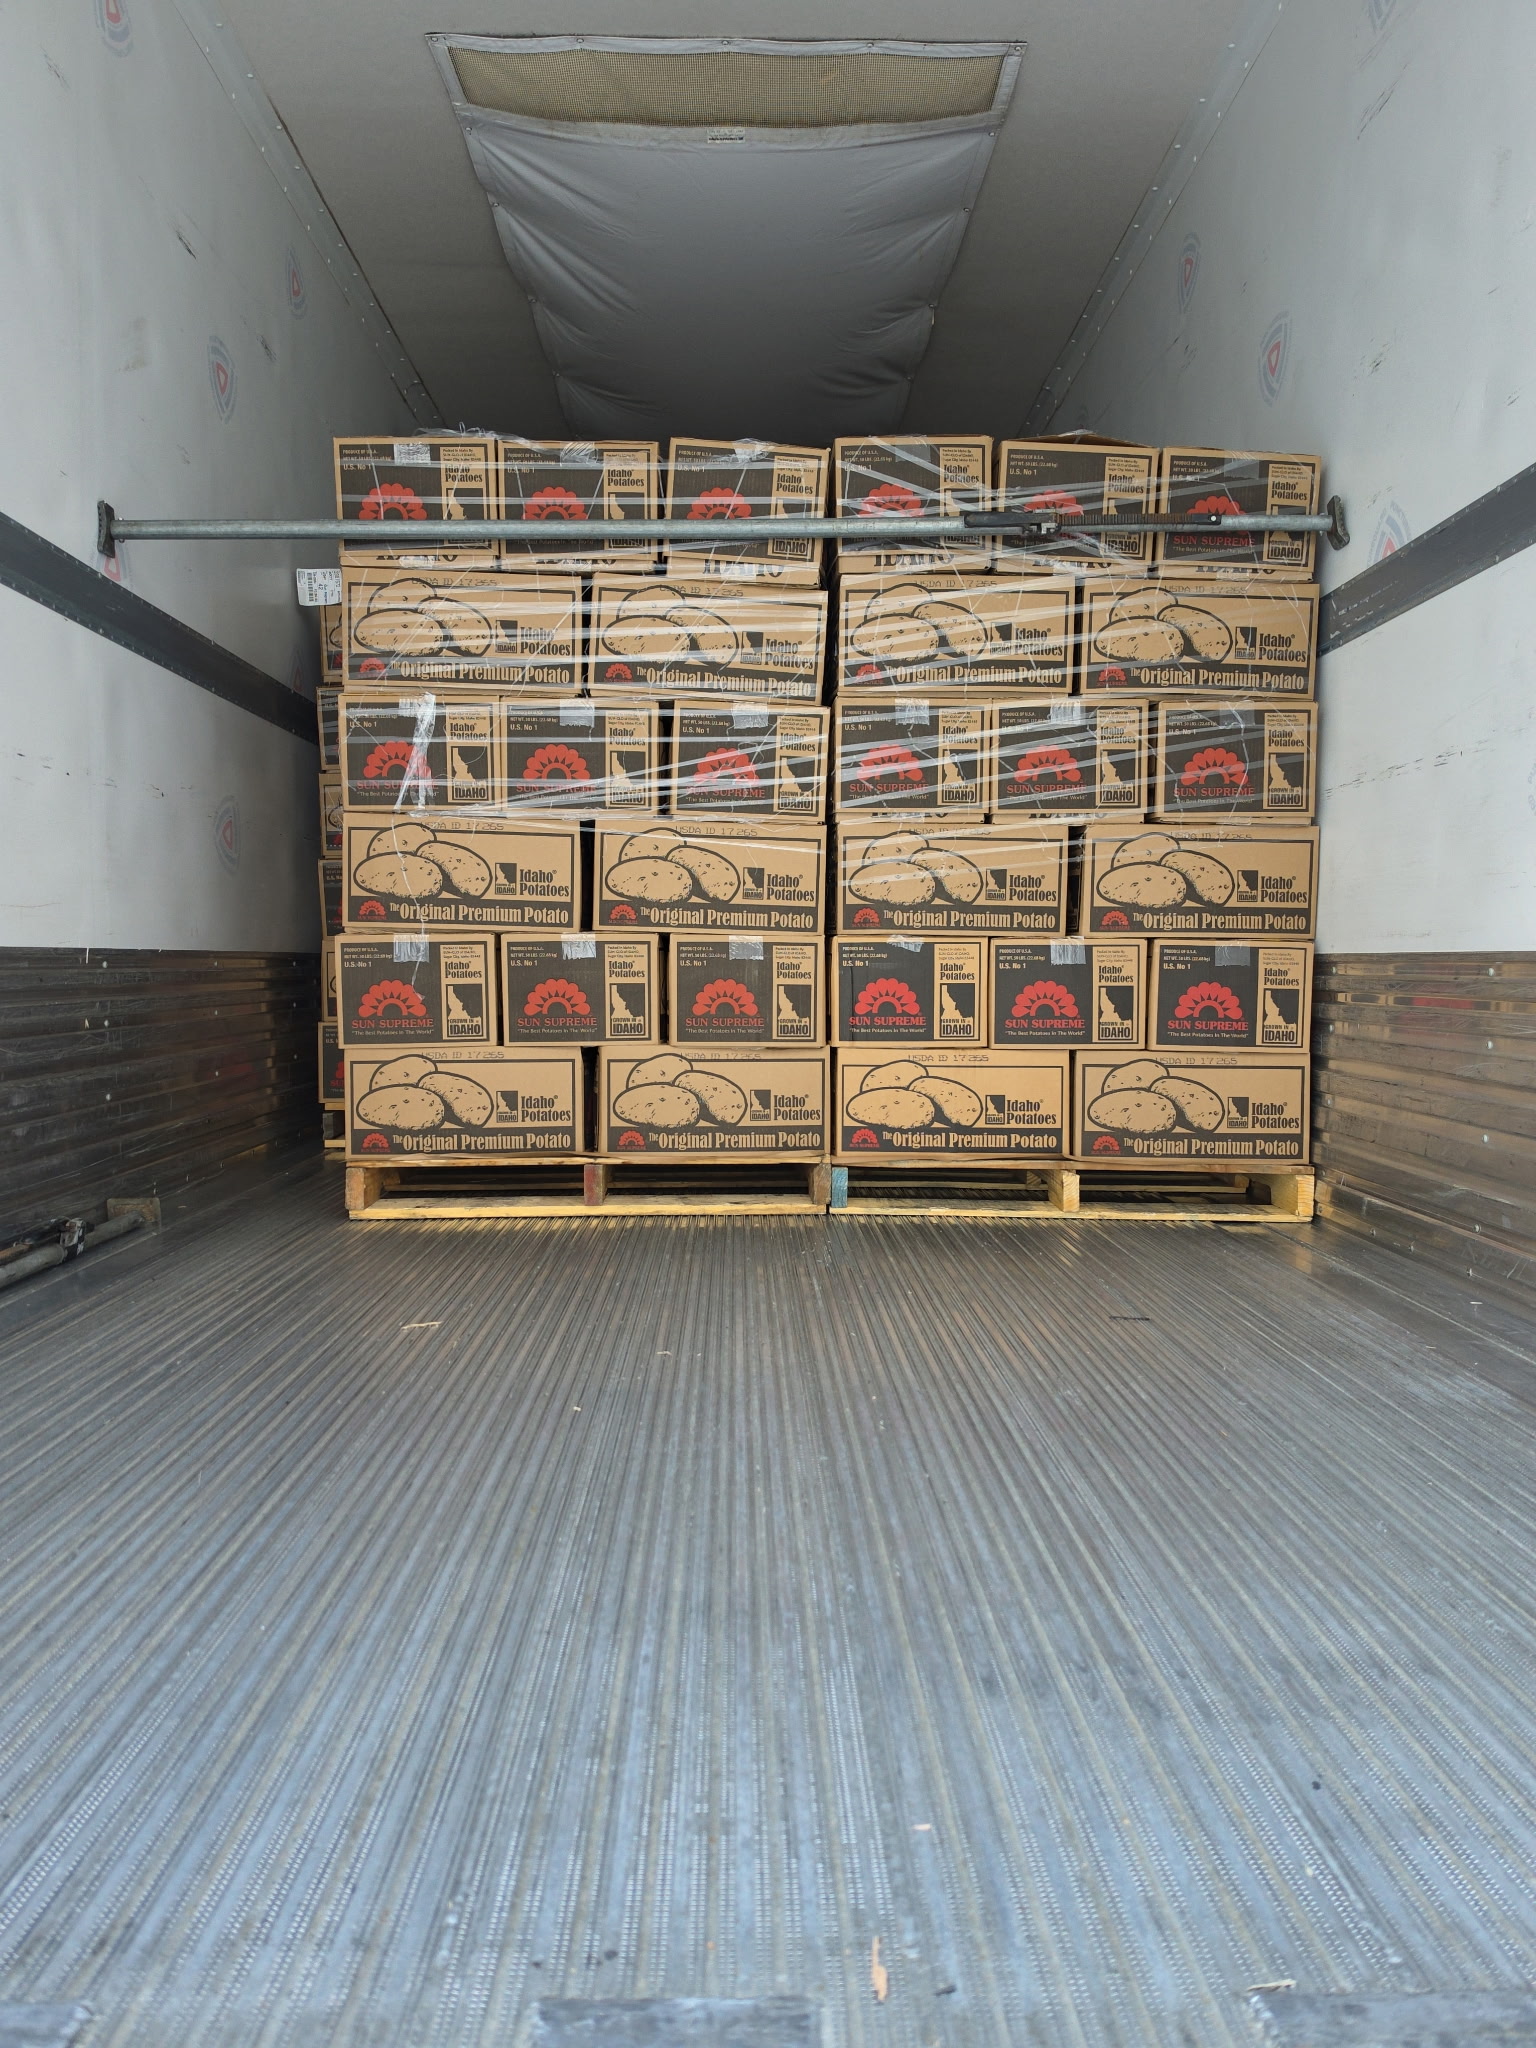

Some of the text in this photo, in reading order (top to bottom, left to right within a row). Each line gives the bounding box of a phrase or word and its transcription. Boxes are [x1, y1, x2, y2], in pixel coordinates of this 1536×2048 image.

[608, 468, 632, 478] Idaho
[608, 477, 644, 487] Potatoes
[1109, 474, 1133, 484] Idaho
[1109, 483, 1143, 493] Potatoes
[1272, 482, 1296, 491] Idaho
[1272, 491, 1307, 500] Potatoes
[1270, 547, 1300, 558] IDAHO
[765, 638, 798, 654] Idaho
[1260, 634, 1291, 648] Idaho
[765, 653, 814, 669] Potatoes
[1259, 649, 1306, 662] Potatoes
[401, 660, 456, 680] Original
[460, 662, 521, 681] Premium
[524, 665, 570, 684] Potato
[897, 666, 950, 684] Original
[955, 666, 1014, 683] Premium
[1018, 667, 1061, 683] Potato
[647, 668, 701, 690] Original
[705, 672, 764, 694] Premium
[768, 678, 811, 697] Potato
[1141, 668, 1195, 686] Original
[1200, 670, 1258, 687] Premium
[1262, 672, 1304, 689] Potato
[610, 728, 633, 737] Idaho
[1269, 729, 1292, 739] Idaho
[610, 737, 645, 747] Potatoes
[1269, 738, 1304, 748] Potatoes
[1174, 787, 1254, 798] SUN SUPREME
[1270, 794, 1300, 805] IDAHO
[519, 869, 552, 882] Idaho
[767, 874, 799, 887] Idaho
[1010, 875, 1041, 888] Idaho
[1261, 876, 1292, 889] Idaho
[520, 884, 569, 897] Potatoes
[767, 888, 814, 901] Potatoes
[1009, 889, 1056, 901] Potatoes
[1261, 890, 1307, 902] Potatoes
[390, 902, 568, 924] The Original Premium Potato
[641, 906, 813, 928] The Original Premium Potato
[884, 909, 1055, 928] The Original Premium Potato
[1134, 912, 1306, 931] The Original Premium Potato
[446, 961, 469, 970] Idaho
[610, 961, 633, 970] Idaho
[778, 962, 800, 971] Idaho
[941, 963, 963, 971] Idaho
[1099, 966, 1122, 974] Idaho
[446, 970, 481, 979] Potatoes
[610, 969, 644, 978] Potatoes
[778, 971, 811, 980] Potatoes
[940, 972, 974, 980] Potatoes
[1099, 974, 1133, 982] Potatoes
[1264, 968, 1288, 977] Idaho
[1264, 977, 1299, 986] Potatoes
[351, 1018, 434, 1029] SUN SUPREME
[517, 1017, 597, 1027] SUN SUPREME
[686, 1017, 764, 1027] SUN SUPREME
[848, 1017, 927, 1025] SUN SUPREME
[1005, 1020, 1085, 1028] SUN SUPREME
[1167, 1020, 1249, 1031] SUN SUPREME
[1101, 1027, 1130, 1037] IDAHO
[521, 1096, 554, 1108] Idaho
[774, 1095, 805, 1107] Idaho
[1007, 1100, 1040, 1112] Idaho
[774, 1108, 820, 1121] Potatoes
[1252, 1103, 1283, 1115] Idaho
[522, 1109, 571, 1122] Potatoes
[1007, 1112, 1056, 1124] Potatoes
[1251, 1117, 1299, 1128] Potatoes
[393, 1133, 570, 1153] The Original Premium Potato
[649, 1131, 820, 1150] The Original Premium Potato
[883, 1132, 1057, 1148] The Original Premium Potato
[1124, 1137, 1299, 1156] The Original Premium Potato
